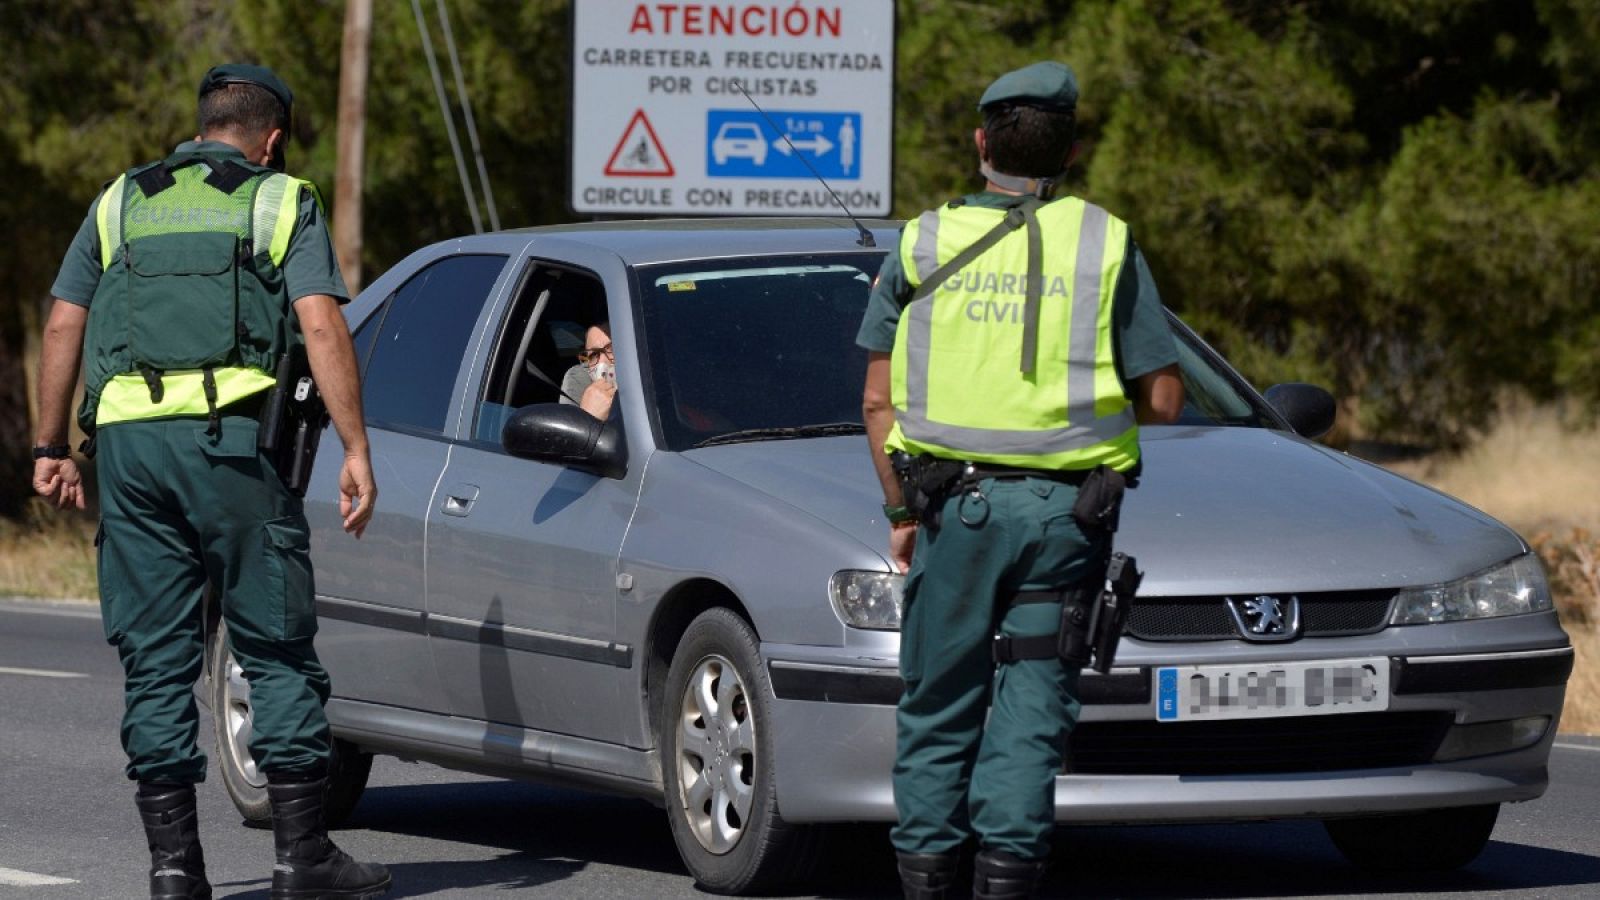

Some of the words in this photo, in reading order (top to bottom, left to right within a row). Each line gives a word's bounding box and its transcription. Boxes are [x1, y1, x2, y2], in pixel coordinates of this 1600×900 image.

[628, 0, 842, 37] ATENCIÓN
[583, 48, 711, 68] CARRETERA
[725, 50, 883, 71] FRECUENTADA
[648, 76, 692, 94] POR
[705, 77, 818, 96] CICLISTAS
[583, 187, 673, 206] CIRCULE
[686, 188, 733, 207] CON
[745, 187, 881, 208] PRECAUCIÓN
[965, 299, 1027, 324] CIVI
[1163, 699, 1173, 711] E
